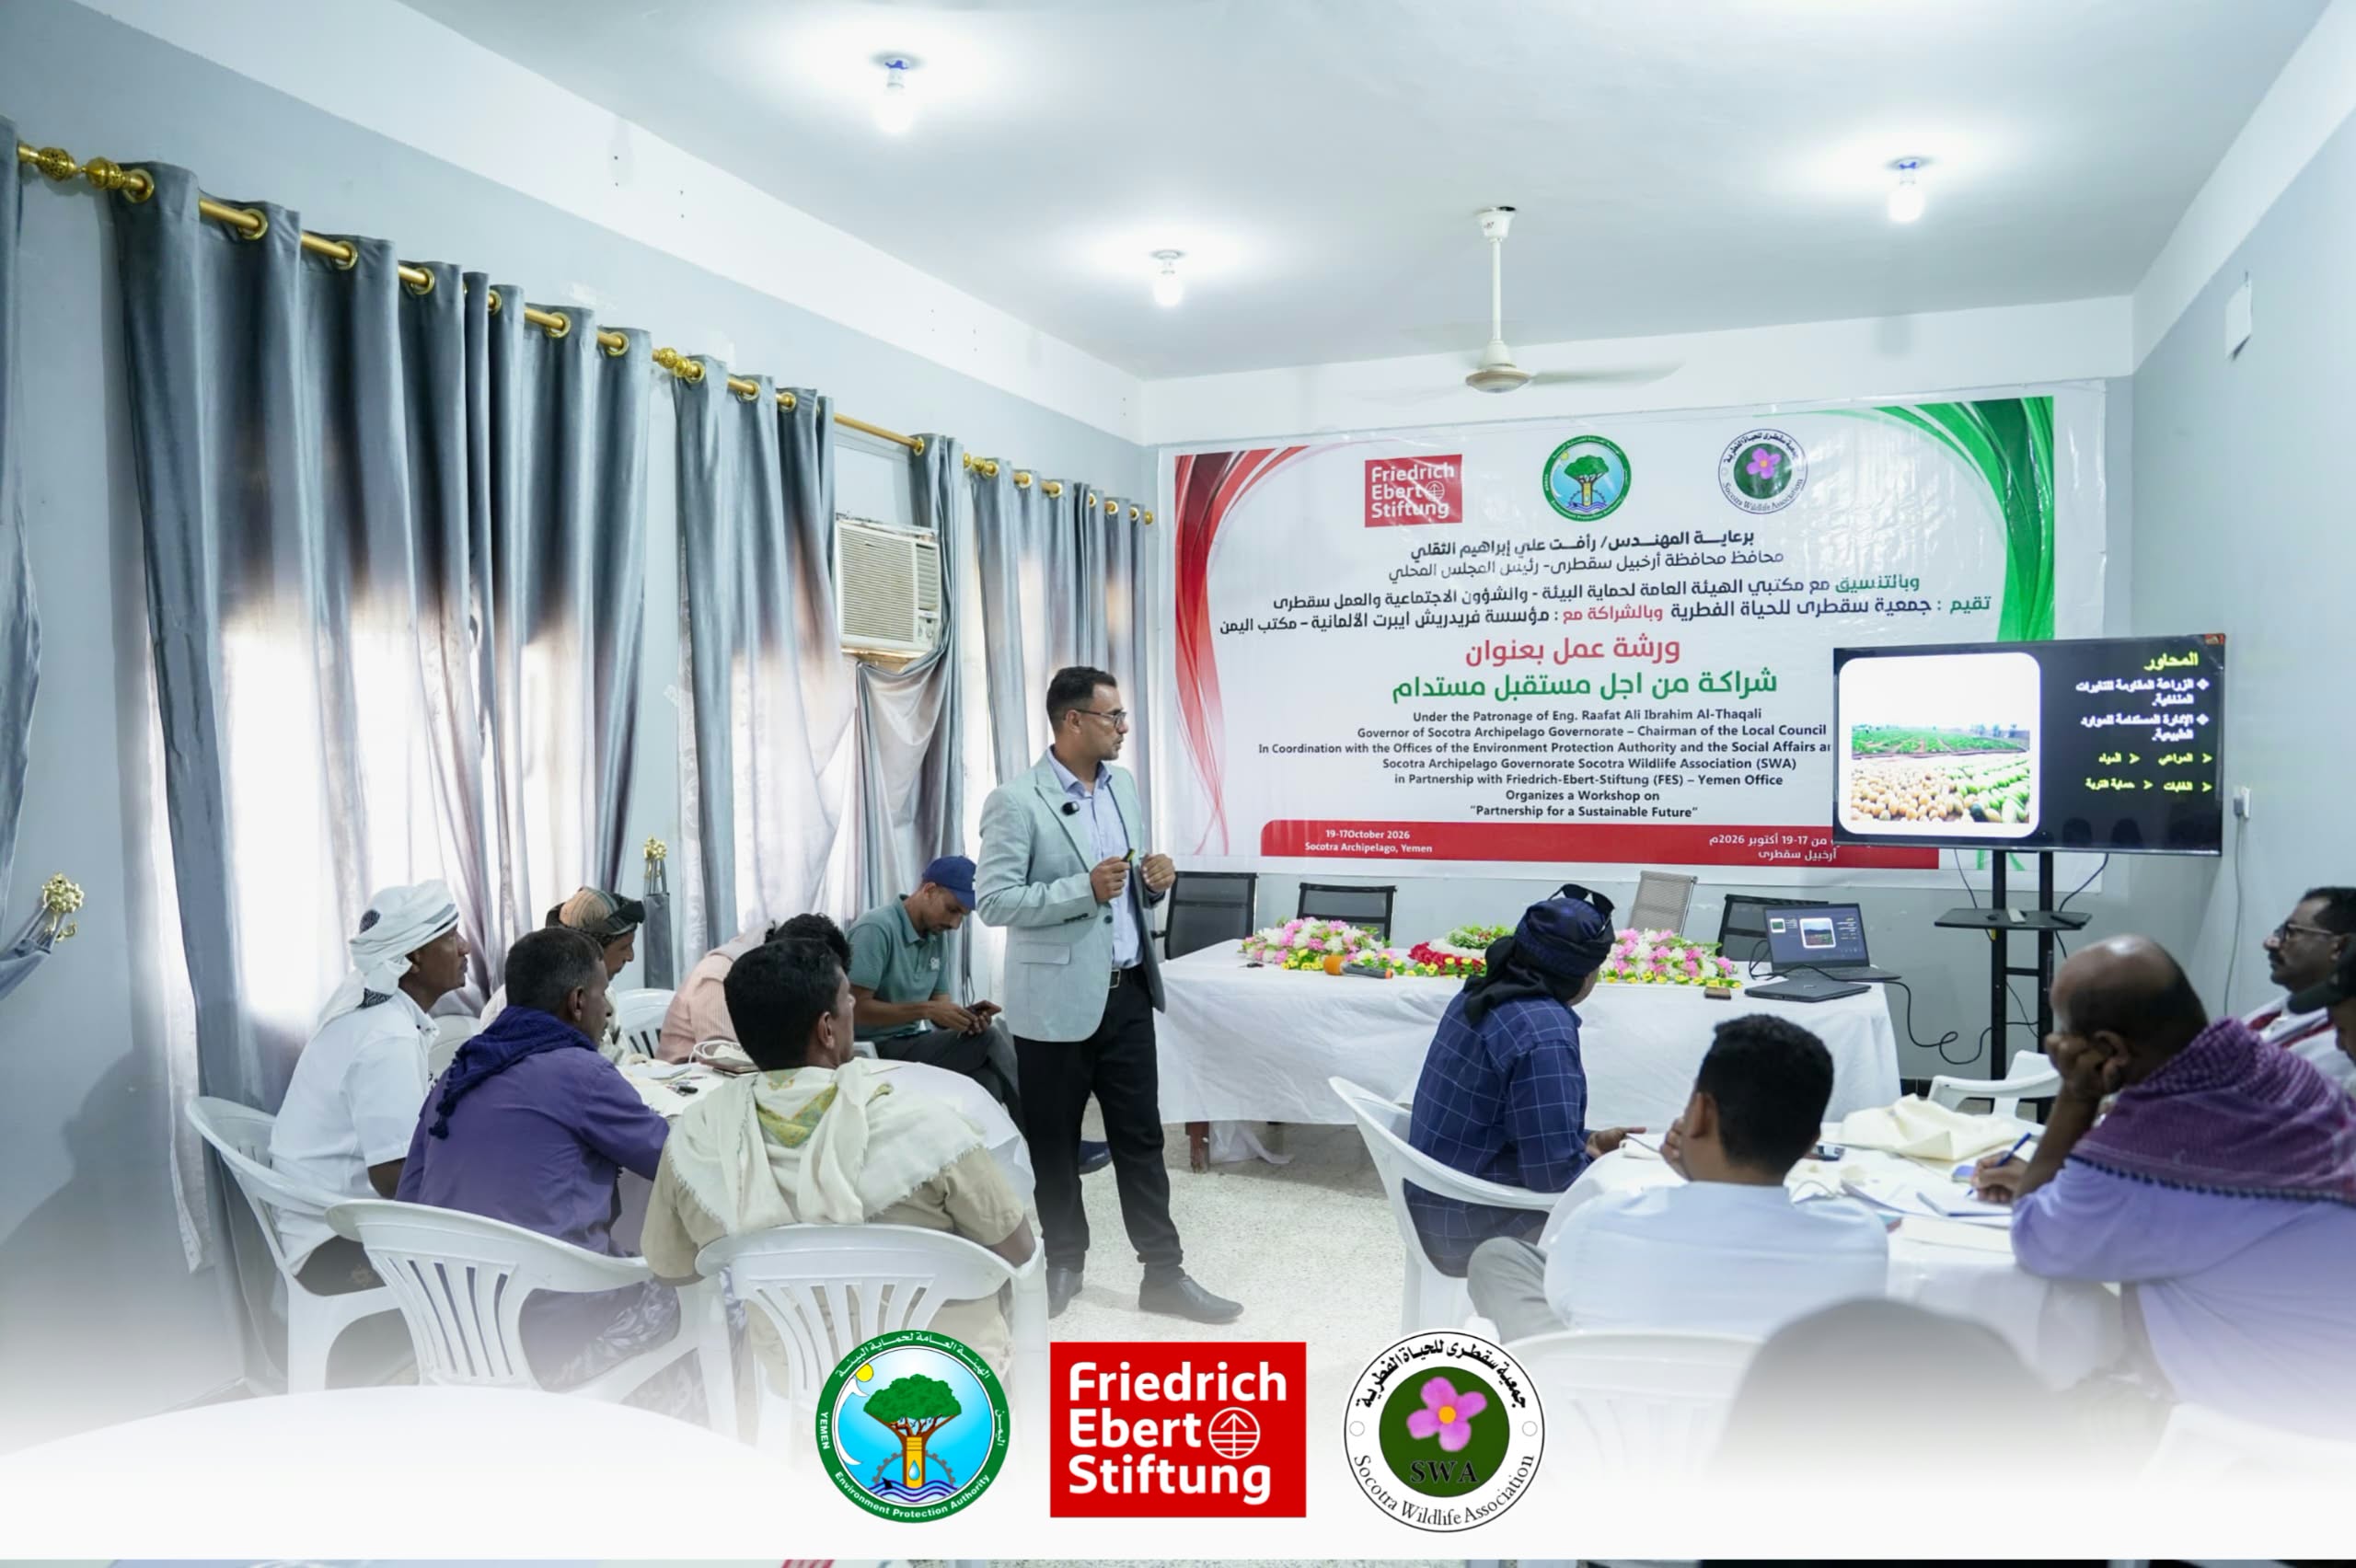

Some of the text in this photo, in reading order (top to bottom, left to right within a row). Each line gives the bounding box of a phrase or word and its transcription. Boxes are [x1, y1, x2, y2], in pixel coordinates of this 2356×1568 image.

[1370, 462, 1454, 483] Friedrich
[1371, 483, 1423, 501] Ebert
[1370, 500, 1449, 519] Stiftung
[1411, 542, 1456, 563] الثقلي
[1460, 540, 1510, 559] إبراهيم
[1514, 538, 1546, 559] علي
[1730, 550, 1784, 564] محافظ
[1500, 558, 1539, 576] رئيس
[1616, 551, 1660, 572] أرخبيل
[1665, 552, 1727, 567] محافظة
[1389, 563, 1437, 584] المحلي
[1441, 560, 1495, 579] المجلس
[1274, 574, 1920, 612] وبالتنسيق مع مكتبي الهيئة العامة لحماية البيئة والشؤون الاجتماعية والعمل سقطرى
[1219, 596, 1992, 635] تقيم جمعية سقطرى للحياة الفطرية وبالشراكة مع مؤسسة فريدريش ايبرت الألمانية مكتب اليمن
[1466, 633, 1680, 667] ورشة عمل بعنوان
[2143, 651, 2199, 671] المحاور
[1392, 667, 1777, 704] شراكة من اجل مستقبل مستدام
[1413, 708, 1761, 724] Under the Patronage of Eng. Raafat Ali Ibrahim Al-Thaqali
[1357, 724, 1826, 740] Governor of Socotra Archipelago Governorate Chairman of the Local Council
[1259, 744, 1269, 754] In
[1272, 744, 1342, 754] Coordination
[1345, 743, 1369, 753] with
[1372, 743, 1391, 753] the
[1393, 743, 1432, 753] Offices
[1436, 743, 1448, 753] of
[1450, 743, 1470, 753] the
[1473, 743, 1548, 753] Environment
[1552, 742, 1613, 753] Protection
[1618, 742, 1677, 755] Authority
[1680, 742, 1703, 753] and
[1707, 742, 1728, 752] the
[1732, 741, 1769, 752] Social
[1773, 741, 1816, 752] Affairs
[1382, 757, 1796, 771] Socotra Archipelago Governorate Socotra Wildlife Association (SWA)
[1394, 774, 1783, 788] in Partnership with Friedrich-Ebert-Stiftung (FES) Yemen Office
[1506, 790, 1565, 803] Organizes
[1567, 792, 1575, 801] a
[1577, 790, 1641, 803] Workshop
[1547, 805, 1565, 816] for
[1567, 808, 1575, 816] a
[1578, 806, 1648, 817] Sustainable
[1325, 829, 1410, 839] 19-17October 2026
[1749, 833, 1779, 847] أكتوبر
[1811, 837, 1828, 847] من
[1305, 842, 1433, 855] Socotra Archipelago, Yemen
[1758, 847, 1837, 861] أرخبيل سقطرى
